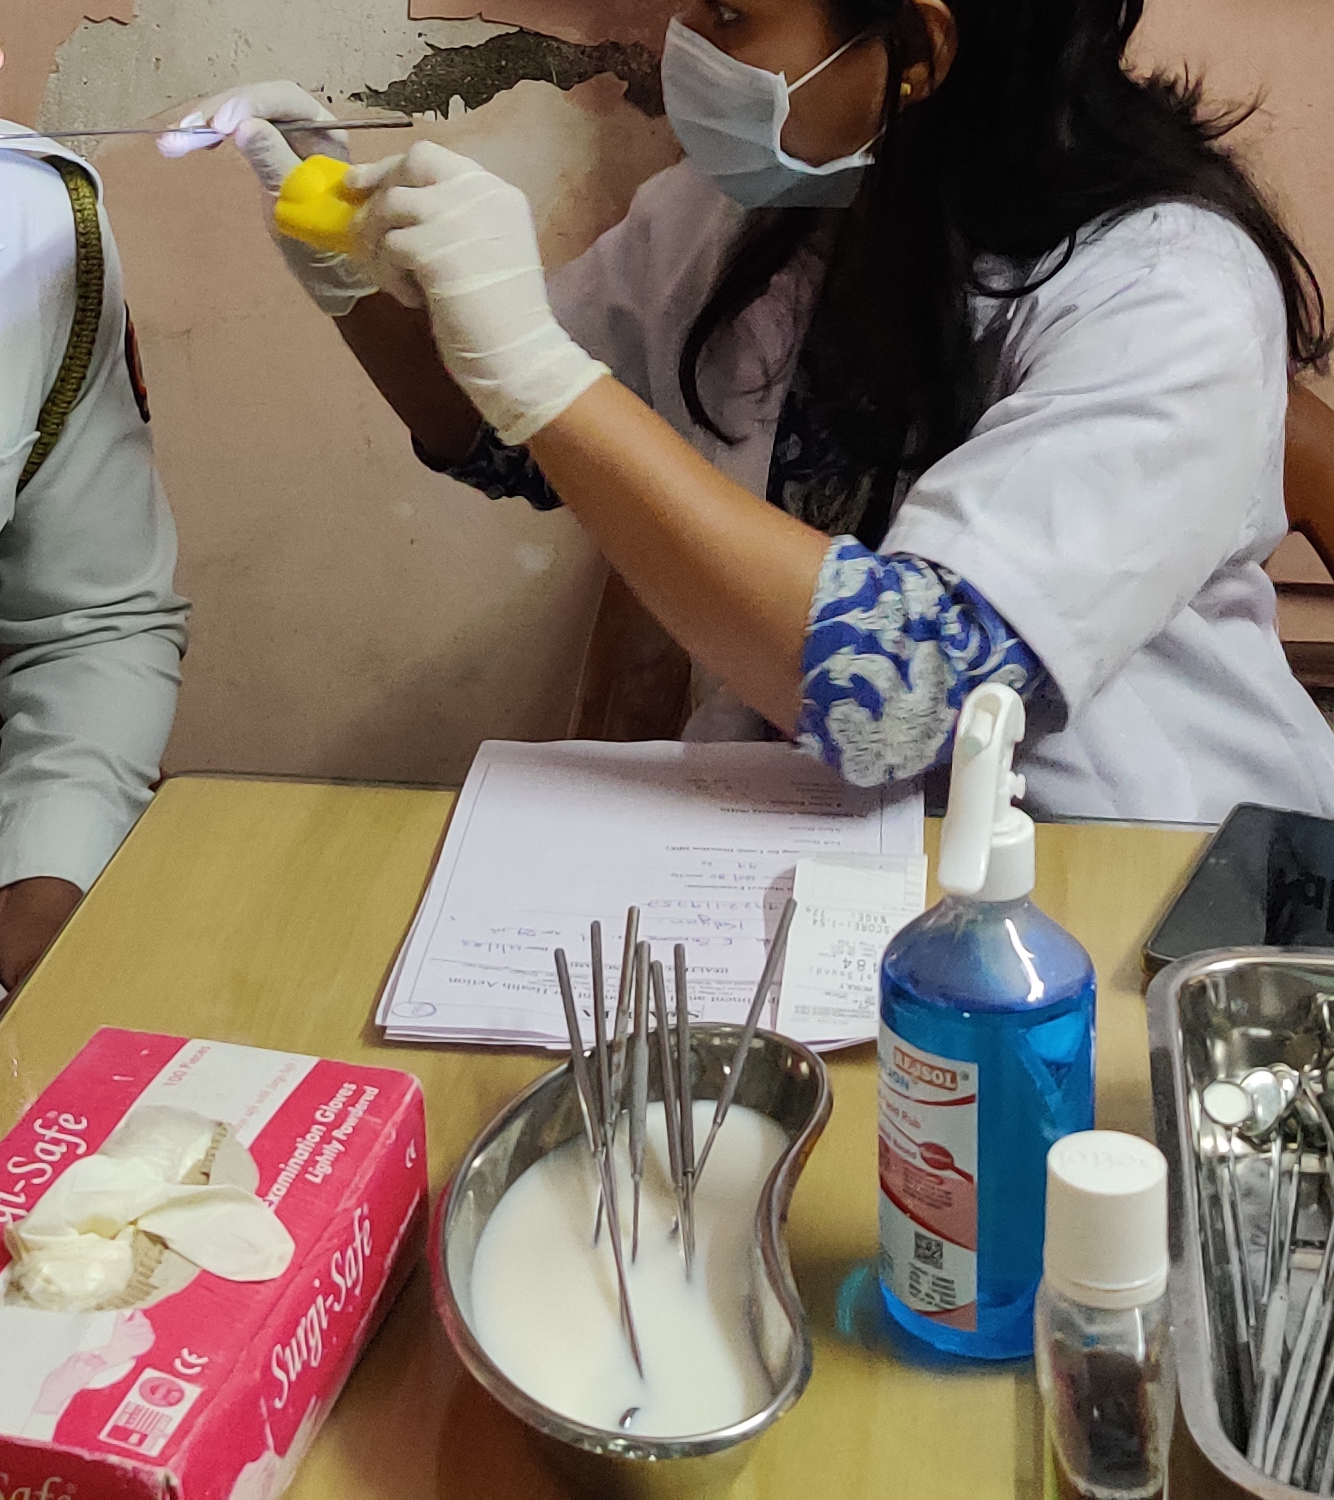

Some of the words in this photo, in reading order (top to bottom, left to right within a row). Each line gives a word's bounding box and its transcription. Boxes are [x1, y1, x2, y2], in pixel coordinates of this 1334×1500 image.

[304, 1139, 346, 1185] Lightly
[331, 1085, 380, 1141] Powdered
[313, 1081, 358, 1123] Gloves
[270, 1206, 373, 1410] Surgi-Safe
